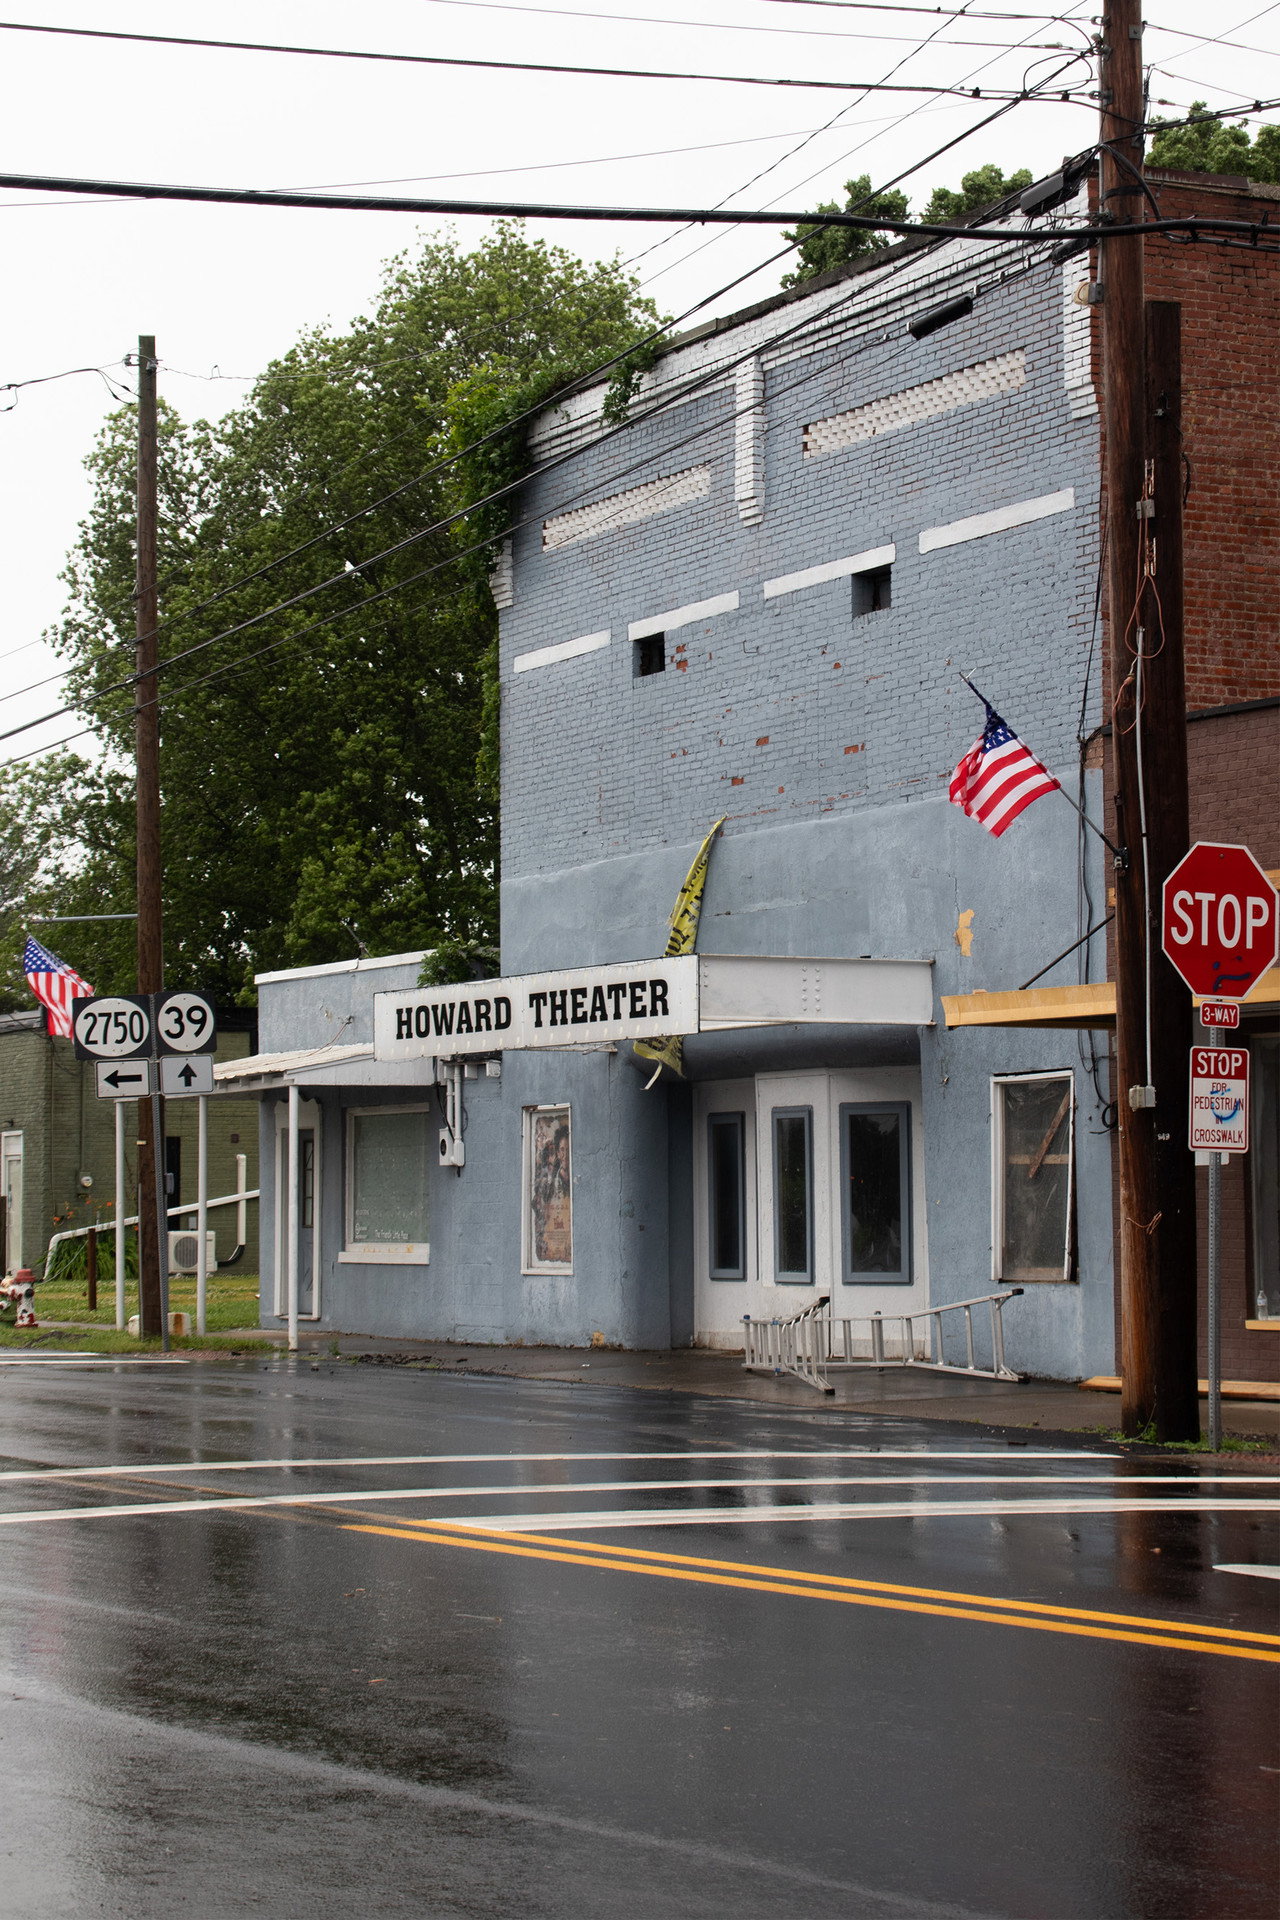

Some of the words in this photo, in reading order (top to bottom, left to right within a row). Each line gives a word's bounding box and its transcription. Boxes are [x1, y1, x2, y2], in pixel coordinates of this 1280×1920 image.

[1170, 889, 1269, 950] STOP
[395, 996, 512, 1040] HOWARD
[528, 978, 670, 1028] THEATER
[1203, 1006, 1236, 1023] 3-WAY
[83, 1010, 144, 1045] 2750
[164, 1005, 207, 1039] 39
[1196, 1051, 1243, 1076] STOP
[1211, 1082, 1227, 1093] FOR
[1194, 1095, 1244, 1111] PEDESTRIAN
[1215, 1114, 1223, 1125] IN
[1194, 1128, 1244, 1143] CROSSWALK
